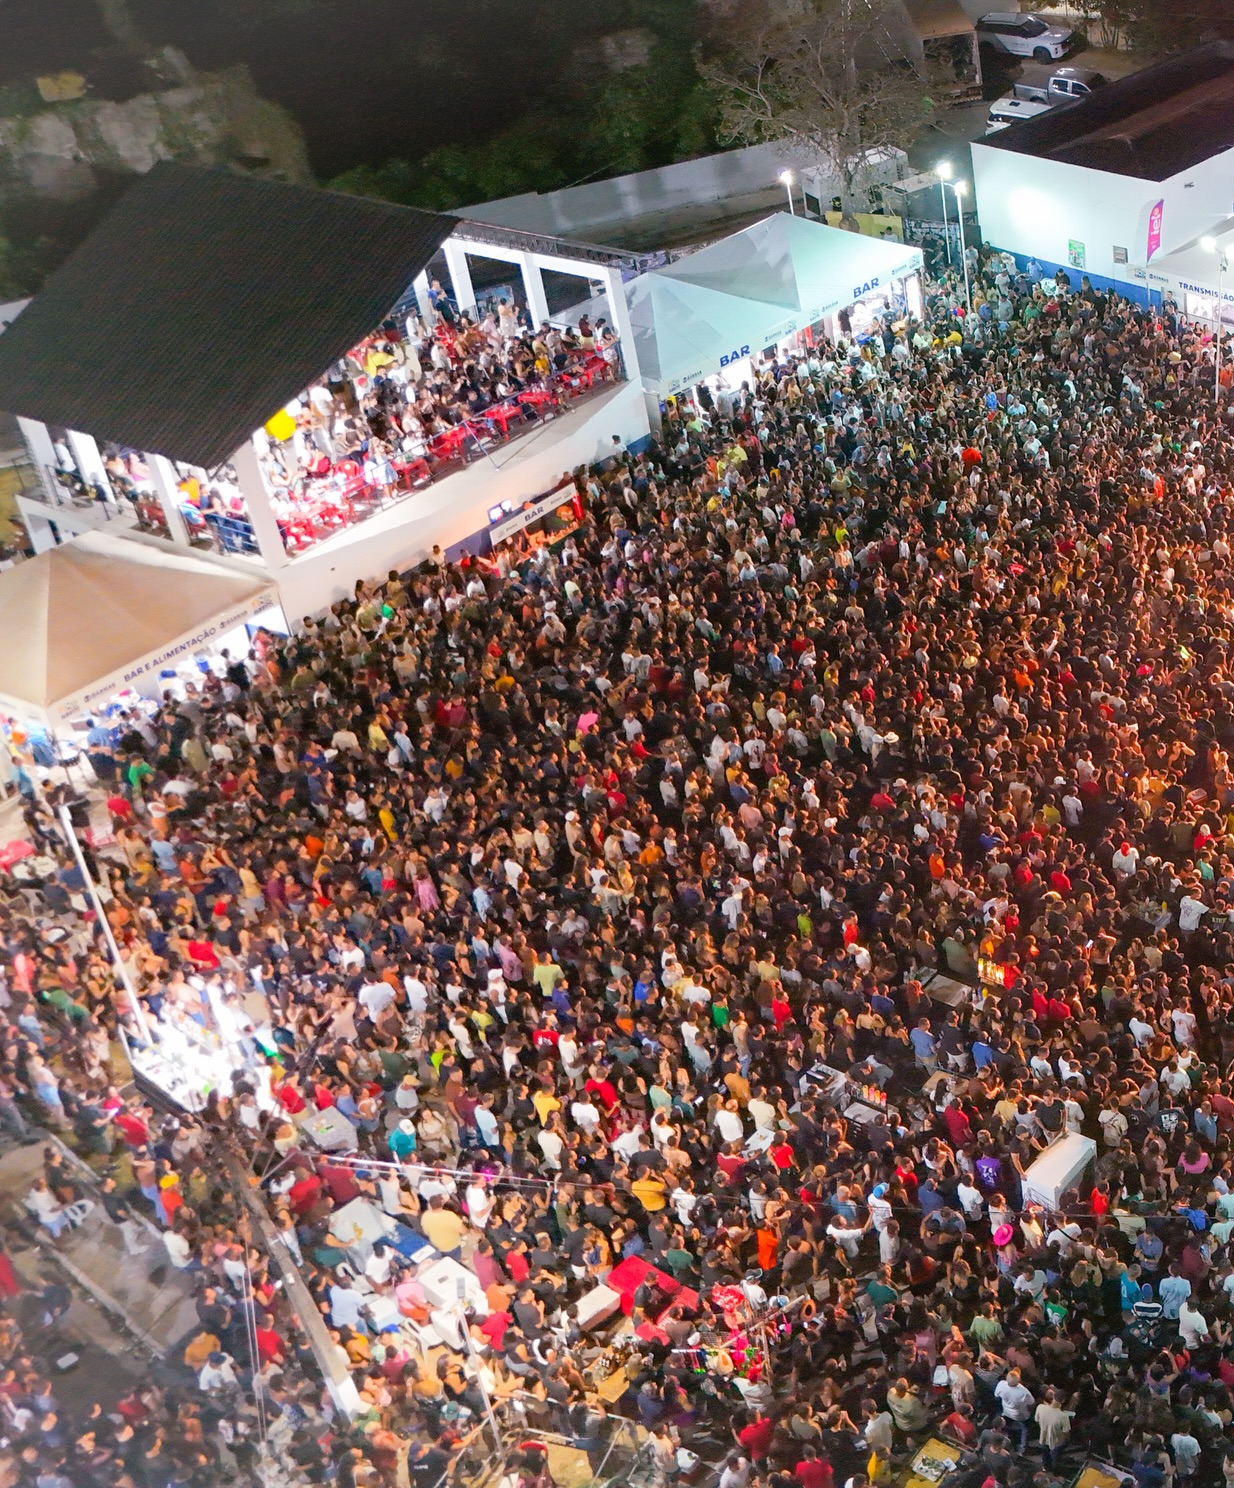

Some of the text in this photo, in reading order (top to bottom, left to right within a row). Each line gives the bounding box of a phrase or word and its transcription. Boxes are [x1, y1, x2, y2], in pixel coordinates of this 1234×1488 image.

[853, 277, 880, 298] BAR
[719, 344, 750, 367] BAR
[524, 506, 544, 522] BAR
[123, 627, 217, 682] BAR E ALIMENTAÇÃO
